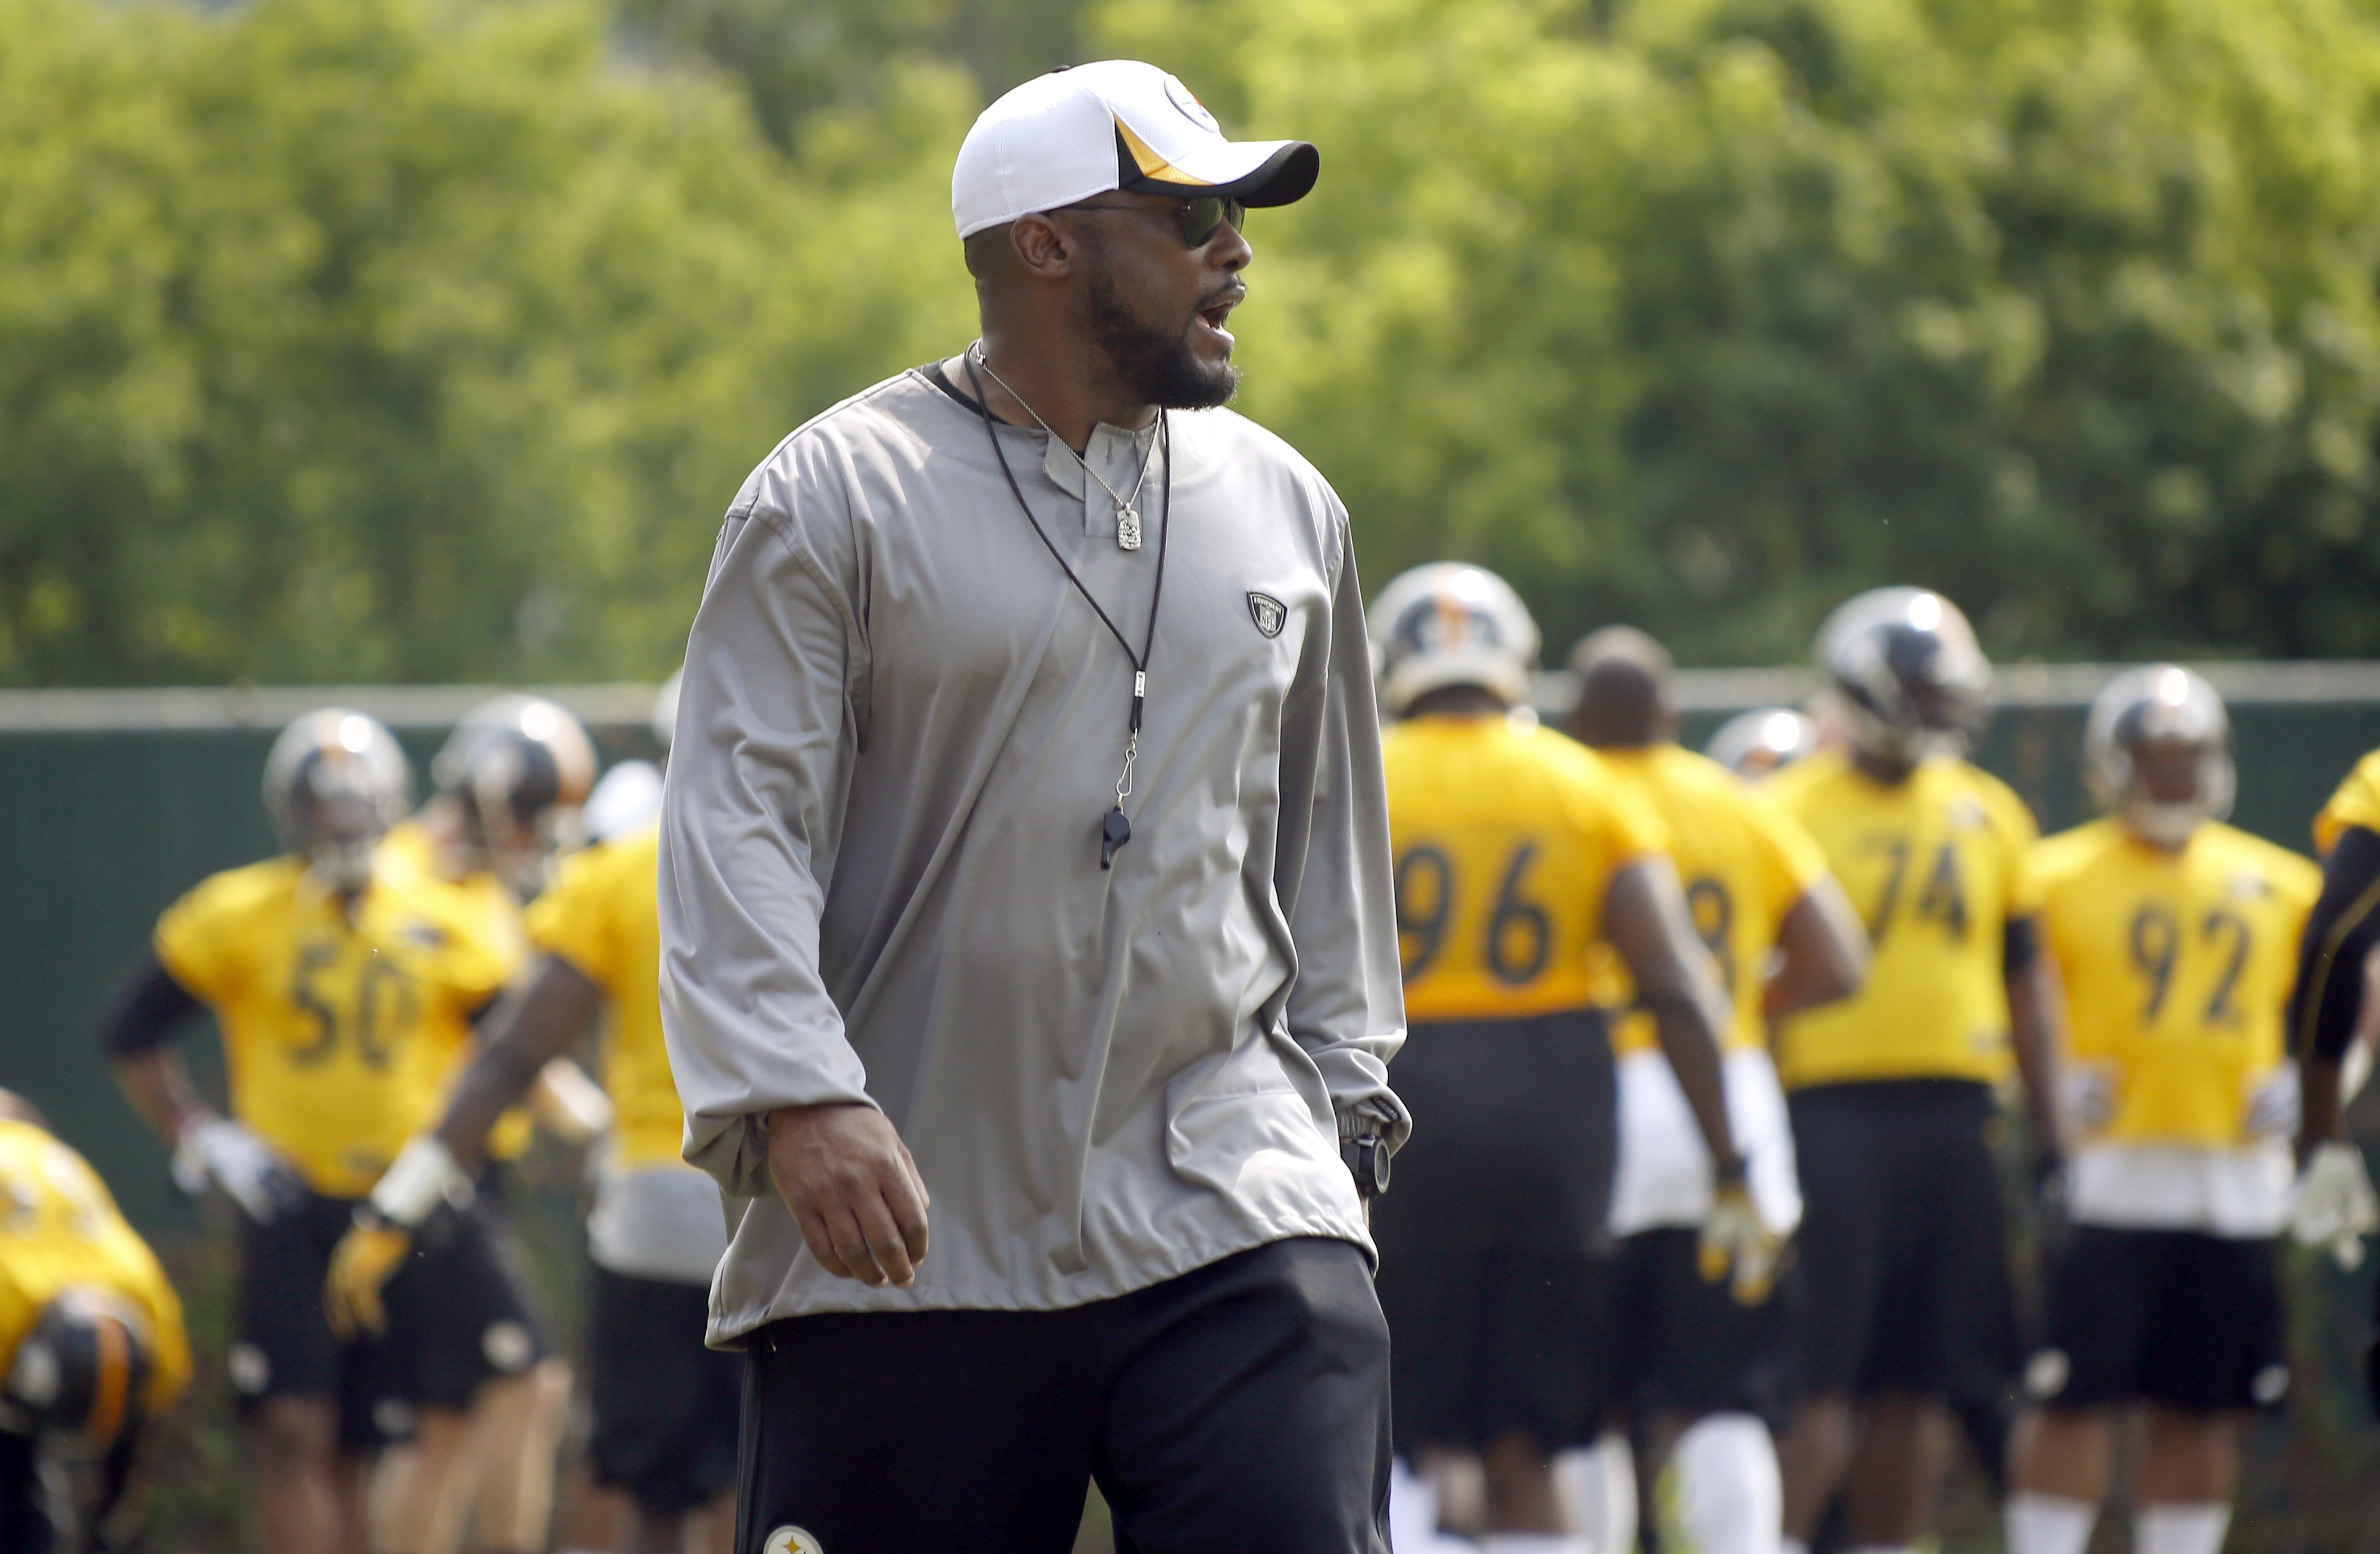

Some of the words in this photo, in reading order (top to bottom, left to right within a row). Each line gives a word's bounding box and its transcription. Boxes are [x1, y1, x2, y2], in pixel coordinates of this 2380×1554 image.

[1254, 597, 1282, 615] EQUIPMENT
[1261, 615, 1275, 629] NFL
[1393, 840, 1552, 986] 96
[1849, 831, 1973, 946] 74
[289, 942, 418, 1071] 50
[2126, 901, 2252, 1030] 92
